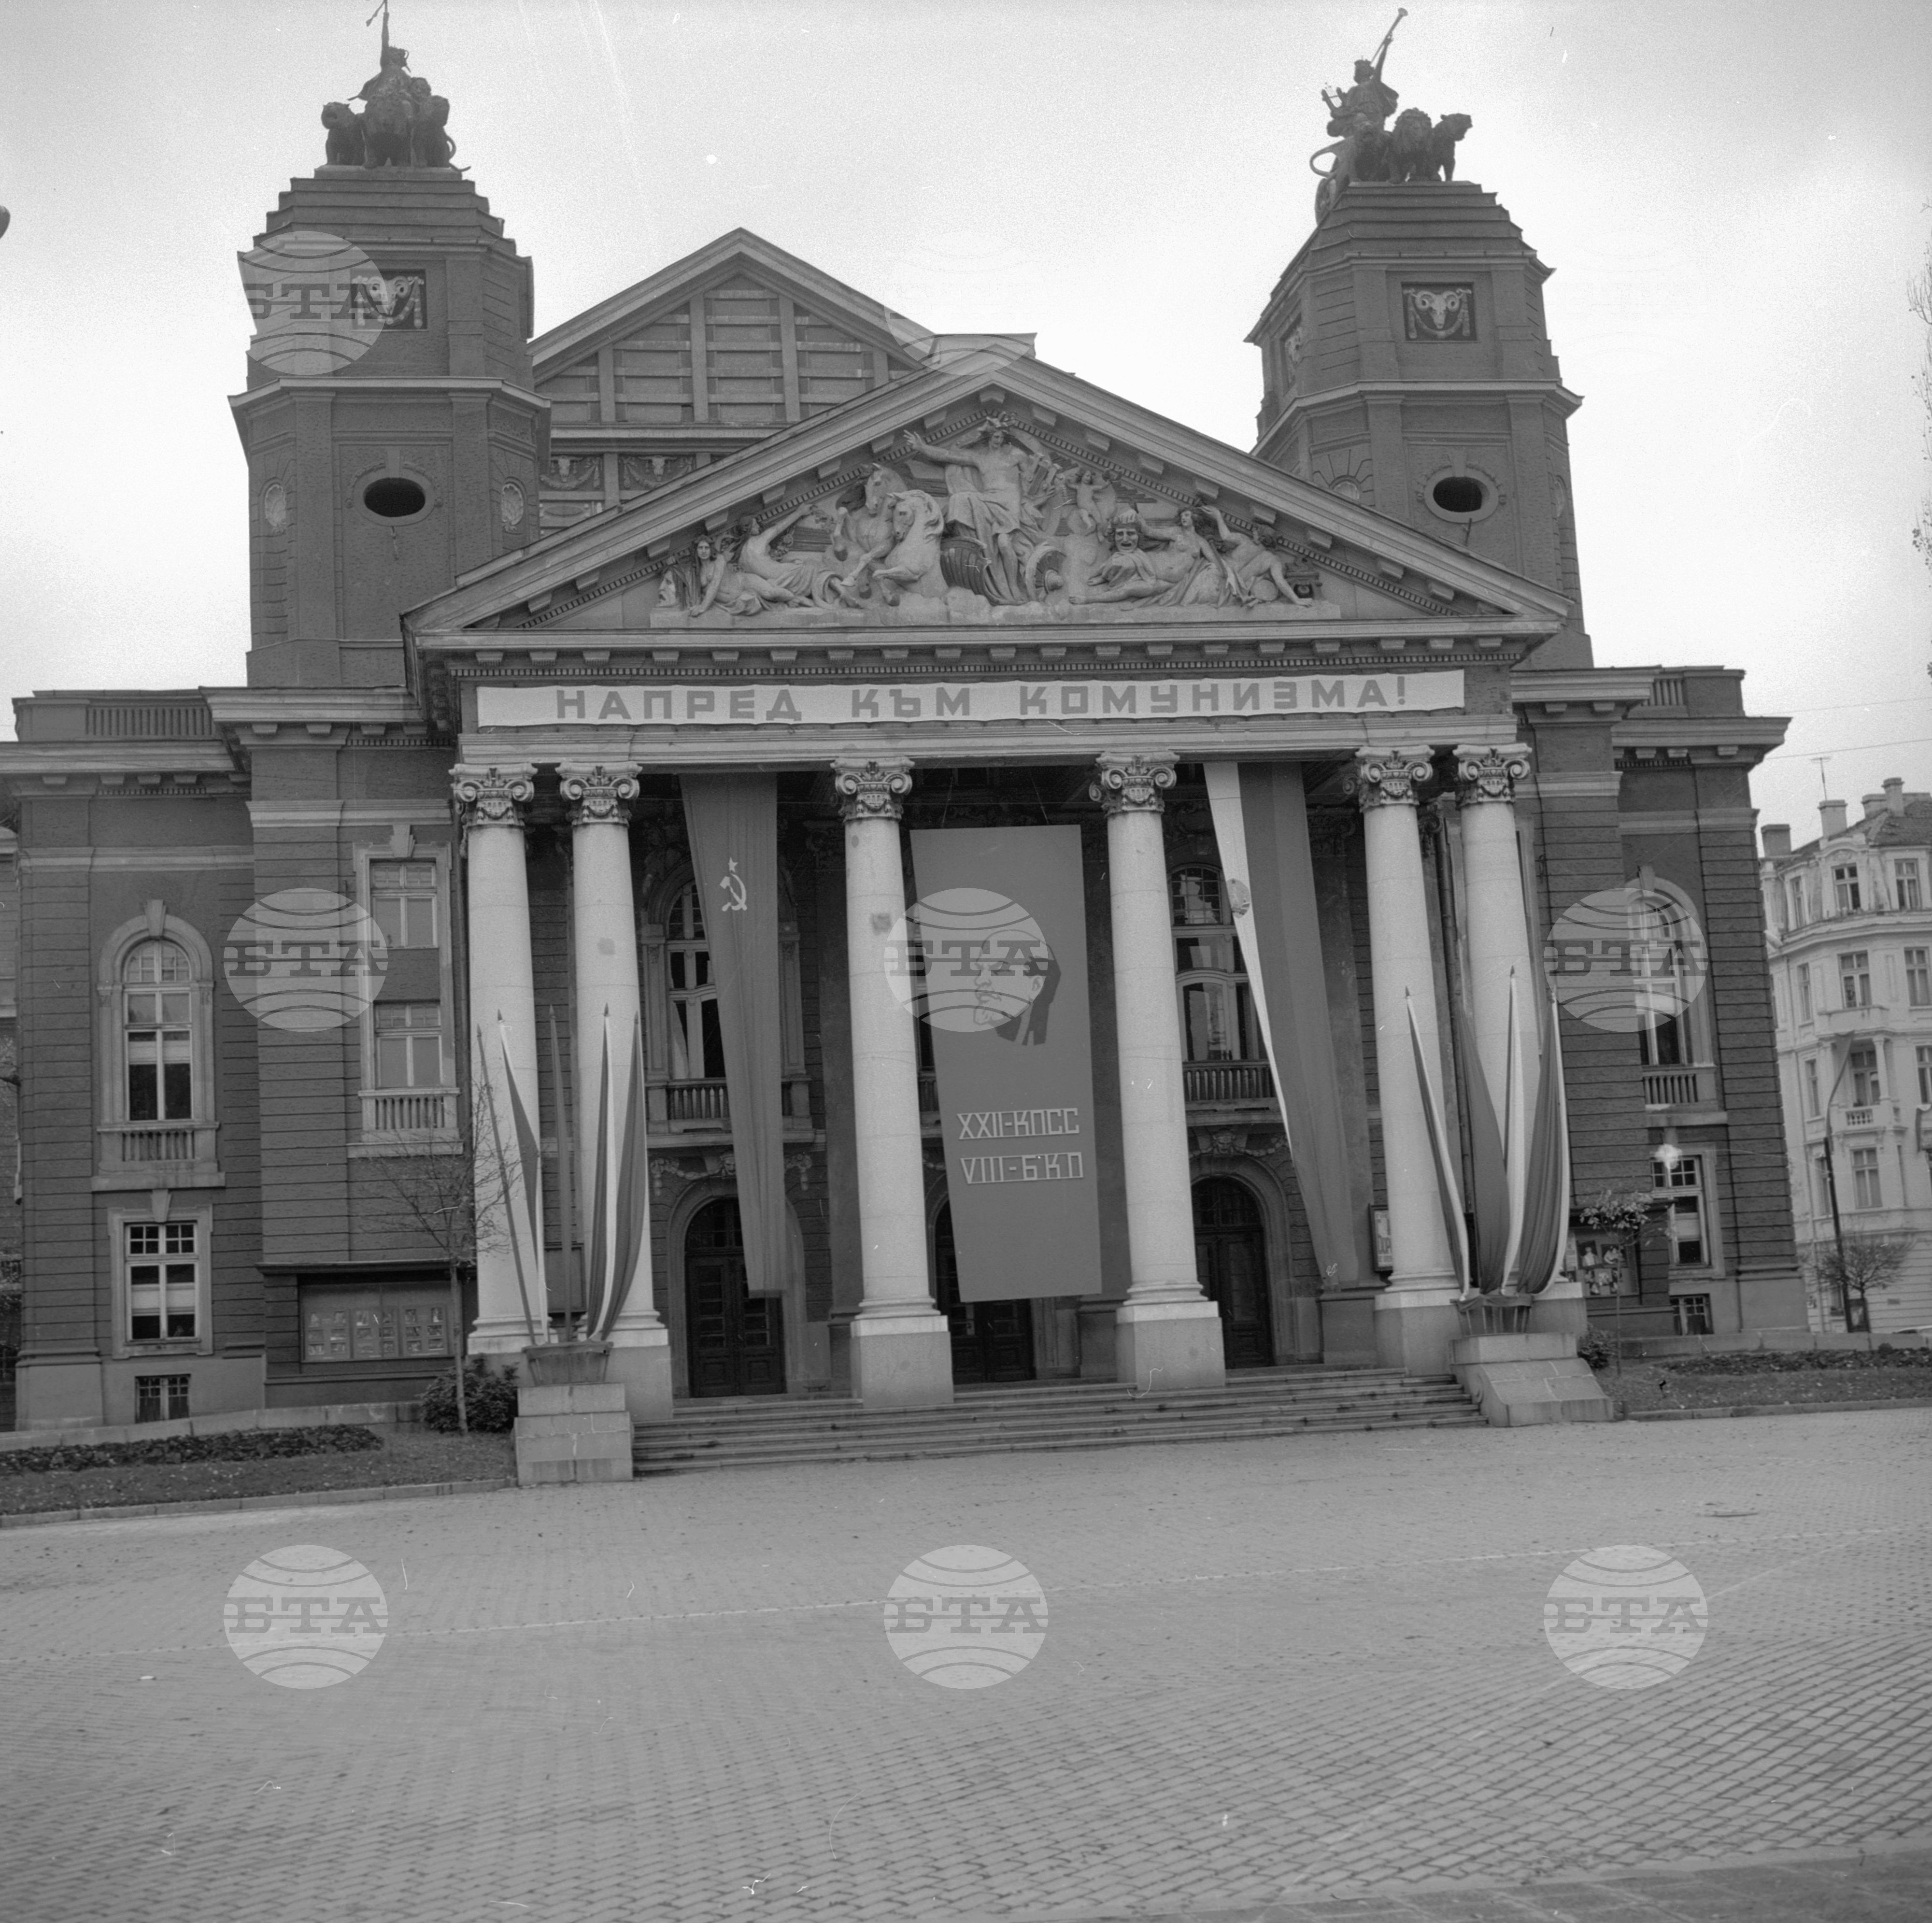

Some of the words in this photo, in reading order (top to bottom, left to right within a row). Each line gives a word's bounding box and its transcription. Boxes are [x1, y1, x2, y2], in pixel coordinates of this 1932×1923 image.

[556, 689, 802, 721] НАПРЕД
[852, 687, 970, 718] КЪМ
[1020, 676, 1406, 715] КОМУНИЗМА!
[957, 1108, 1080, 1140] XXII-КПСС
